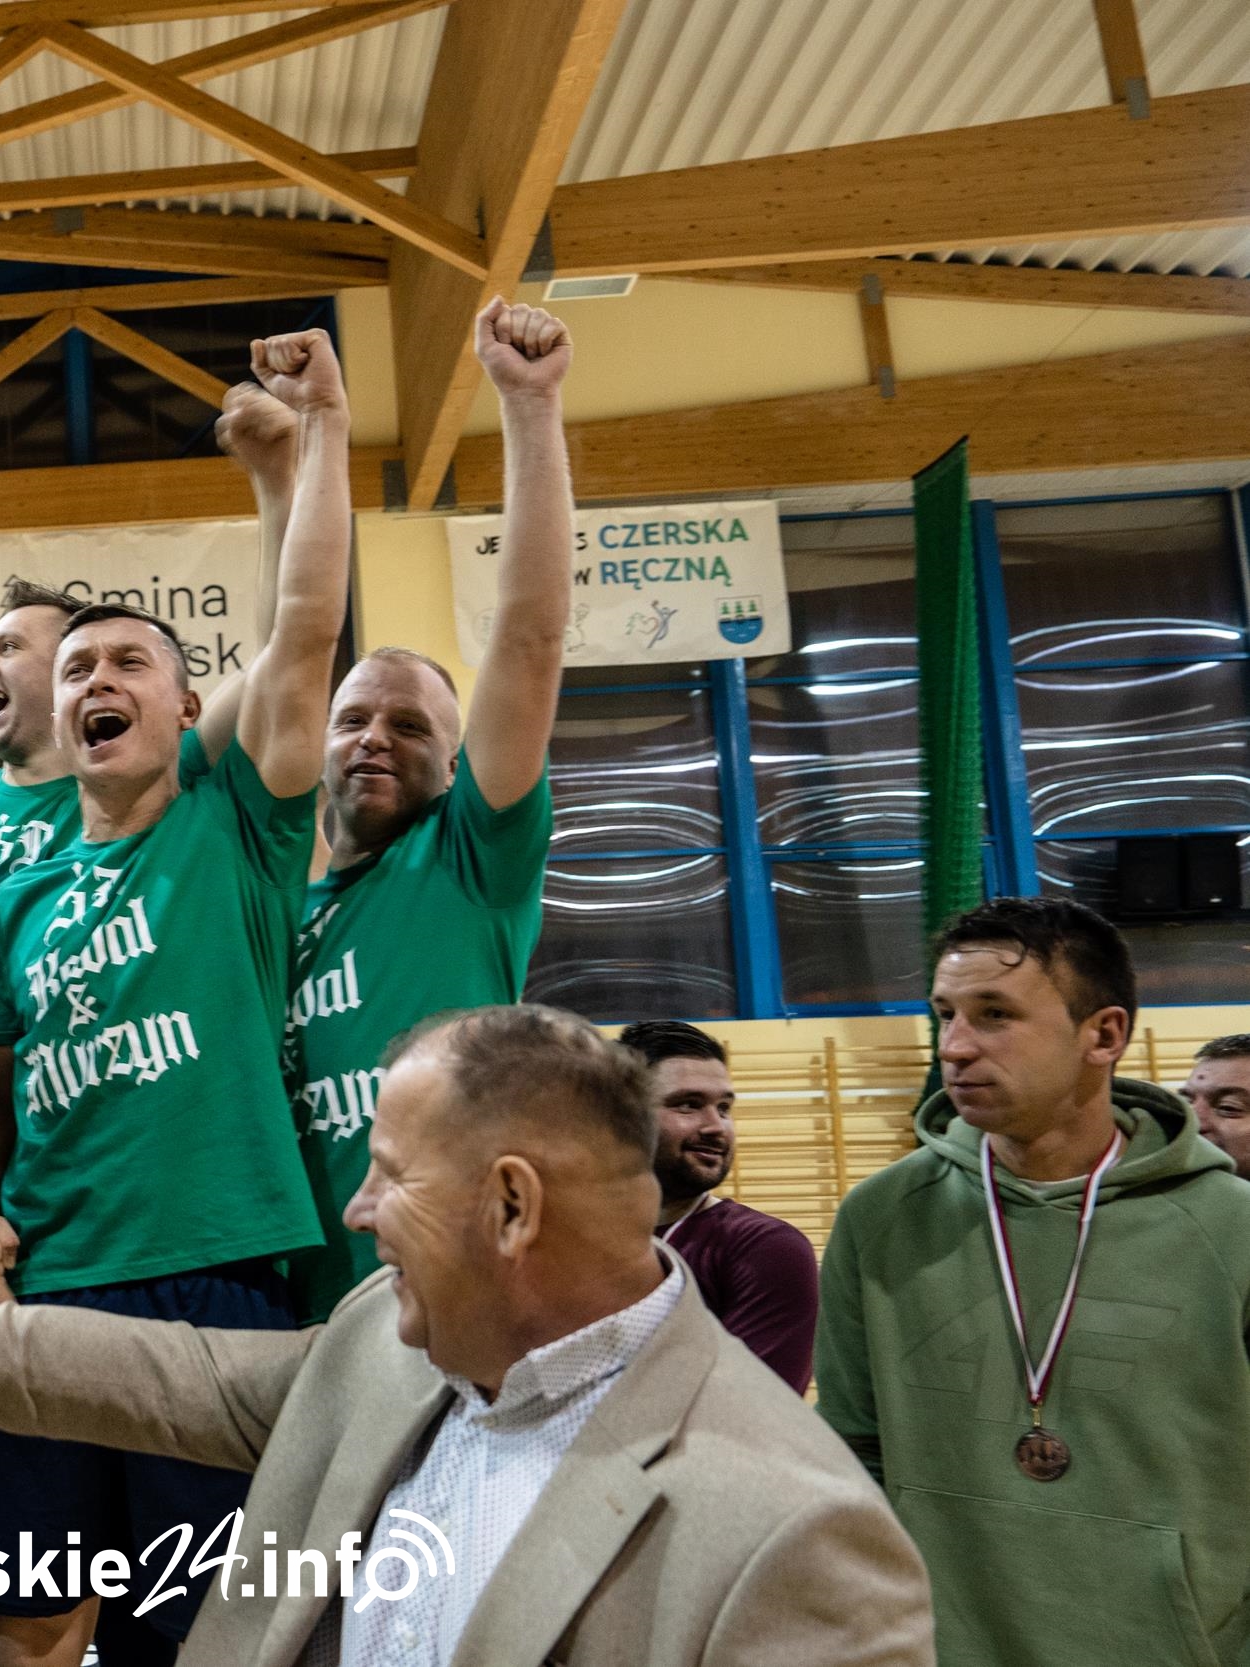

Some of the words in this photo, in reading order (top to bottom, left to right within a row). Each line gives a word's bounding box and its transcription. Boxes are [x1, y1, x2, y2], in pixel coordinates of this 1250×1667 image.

[598, 517, 749, 550] CZERSKA
[599, 555, 732, 590] RĘCZNĄ
[65, 981, 100, 1037] &
